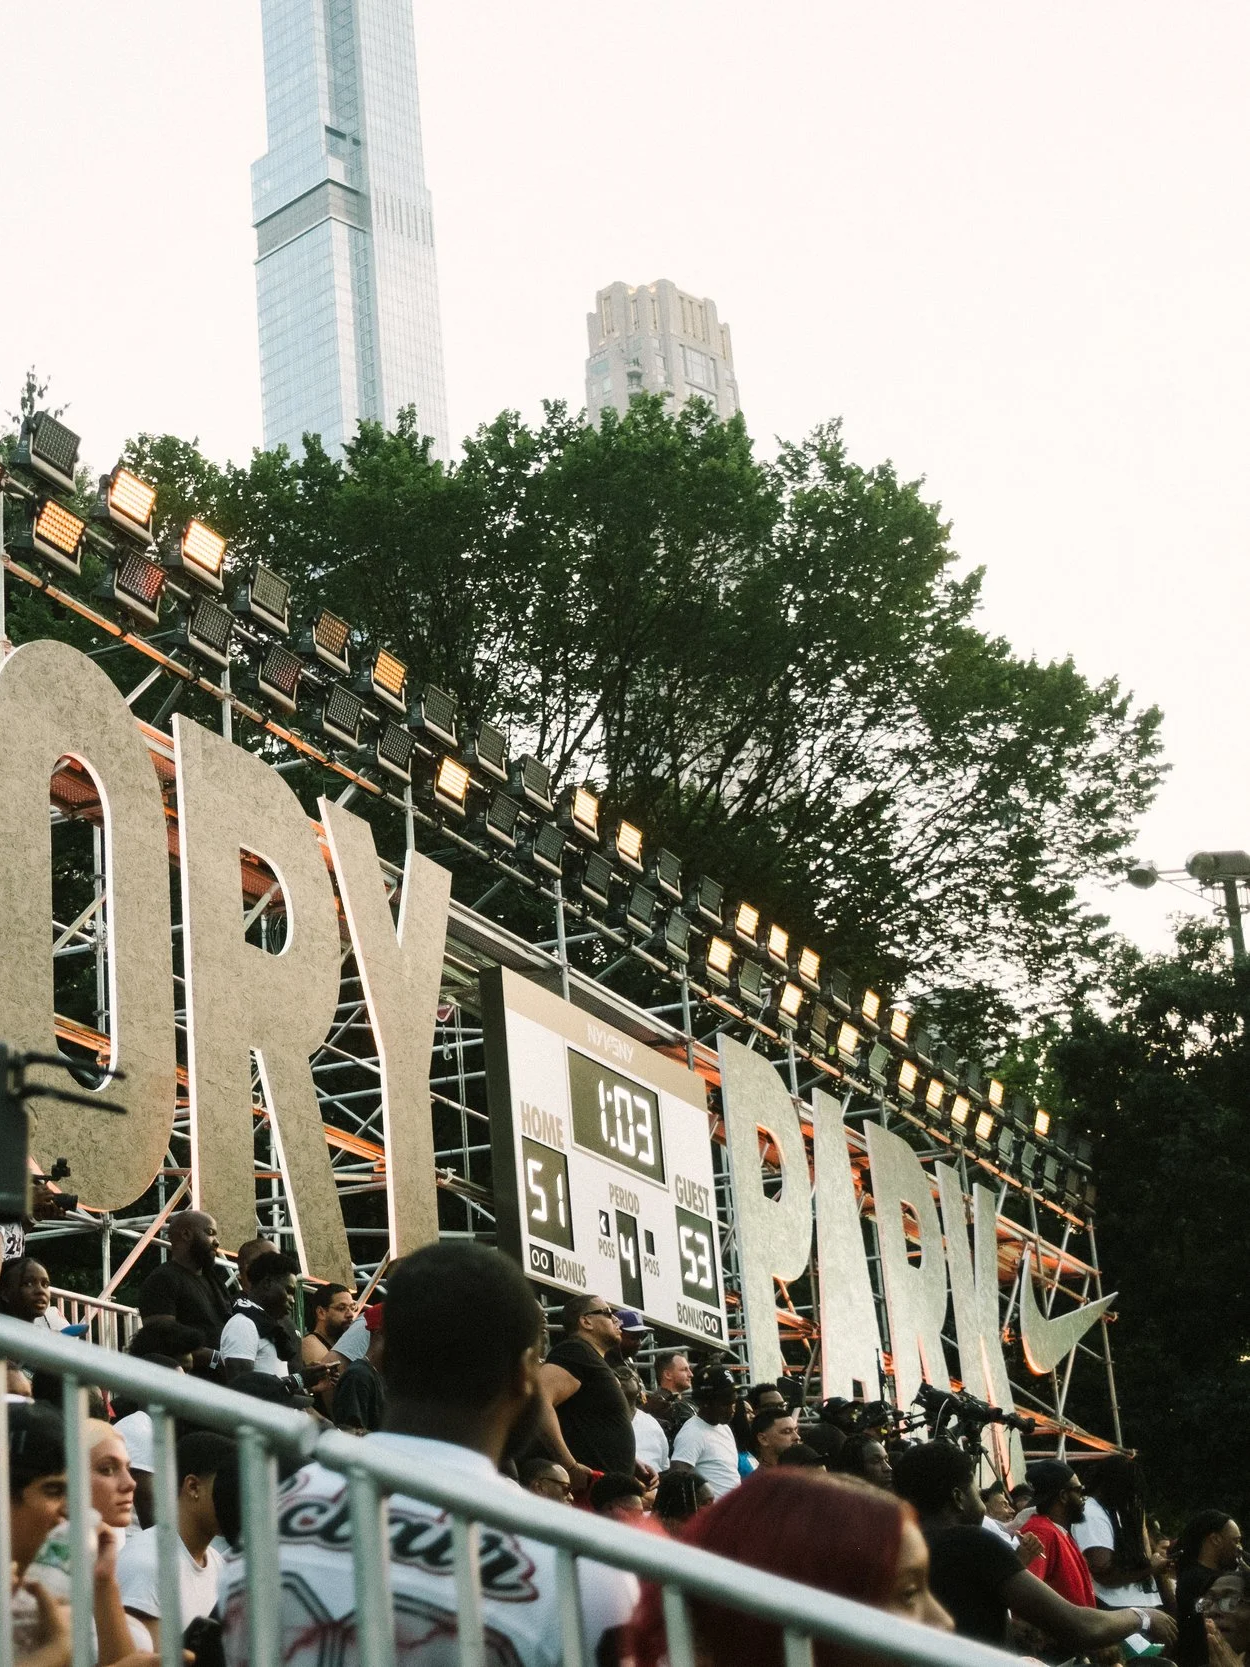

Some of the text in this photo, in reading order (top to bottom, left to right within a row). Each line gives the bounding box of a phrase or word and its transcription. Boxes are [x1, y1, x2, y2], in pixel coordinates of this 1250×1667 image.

[520, 1100, 564, 1150] HOME
[598, 1079, 656, 1166] 1:03
[527, 1158, 566, 1229] 51
[608, 1182, 640, 1215] PERIOD
[675, 1174, 710, 1217] GUEST
[598, 1237, 616, 1260] POSS
[619, 1232, 637, 1280] 4
[643, 1255, 661, 1278] POSS
[679, 1225, 714, 1290] 53
[716, 1032, 1027, 1488] PARK
[554, 1255, 587, 1288] BONUS
[676, 1302, 704, 1332] BONUS
